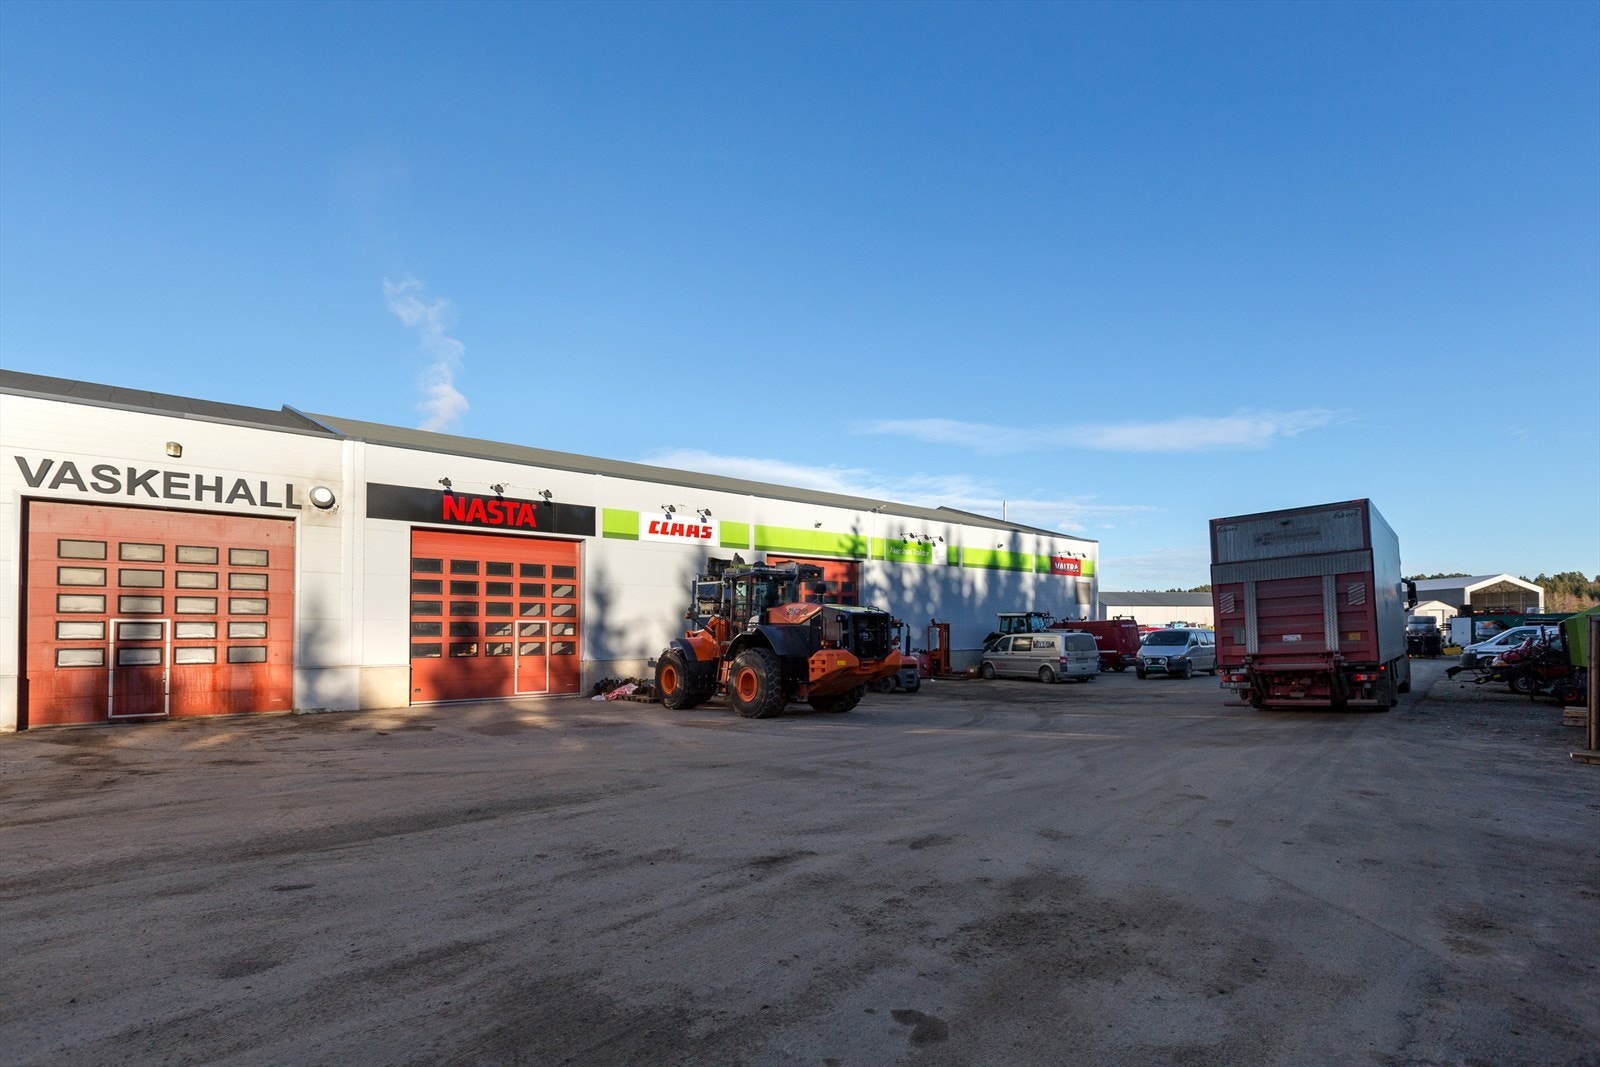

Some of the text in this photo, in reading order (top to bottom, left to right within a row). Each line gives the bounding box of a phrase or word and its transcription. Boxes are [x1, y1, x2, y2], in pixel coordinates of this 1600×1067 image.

[14, 456, 302, 510] VASKEHALL
[443, 494, 537, 528] NASTA
[648, 520, 713, 539] CLAAS
[1054, 562, 1079, 571] VALTRA
